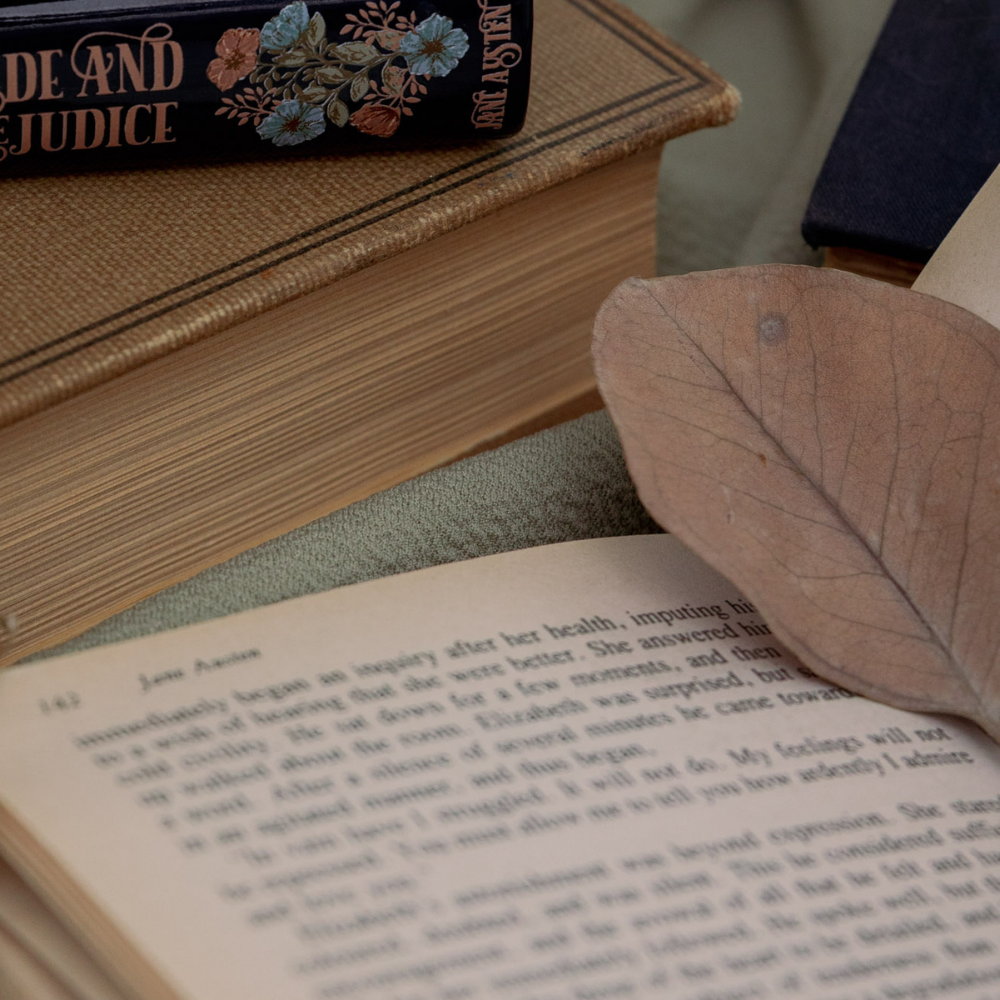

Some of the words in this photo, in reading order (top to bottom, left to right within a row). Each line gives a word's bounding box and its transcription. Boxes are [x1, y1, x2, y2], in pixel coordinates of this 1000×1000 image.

[70, 22, 184, 98] AND
[470, 88, 508, 130] JANE
[444, 637, 498, 660] after
[499, 629, 542, 649] her
[542, 613, 628, 642] health,
[625, 602, 731, 629] imputing
[506, 649, 586, 673] better.
[585, 637, 634, 660] She
[636, 621, 740, 651] answered
[567, 656, 682, 688] moments,
[685, 647, 729, 669] and
[730, 645, 783, 663] then
[641, 670, 756, 700] surprised,
[751, 667, 796, 685] but
[674, 701, 712, 722] he
[713, 696, 776, 717] came
[772, 733, 865, 755] feelings
[865, 726, 913, 746] will
[913, 725, 953, 743] not
[796, 753, 887, 783] ardently
[901, 748, 976, 770] admire
